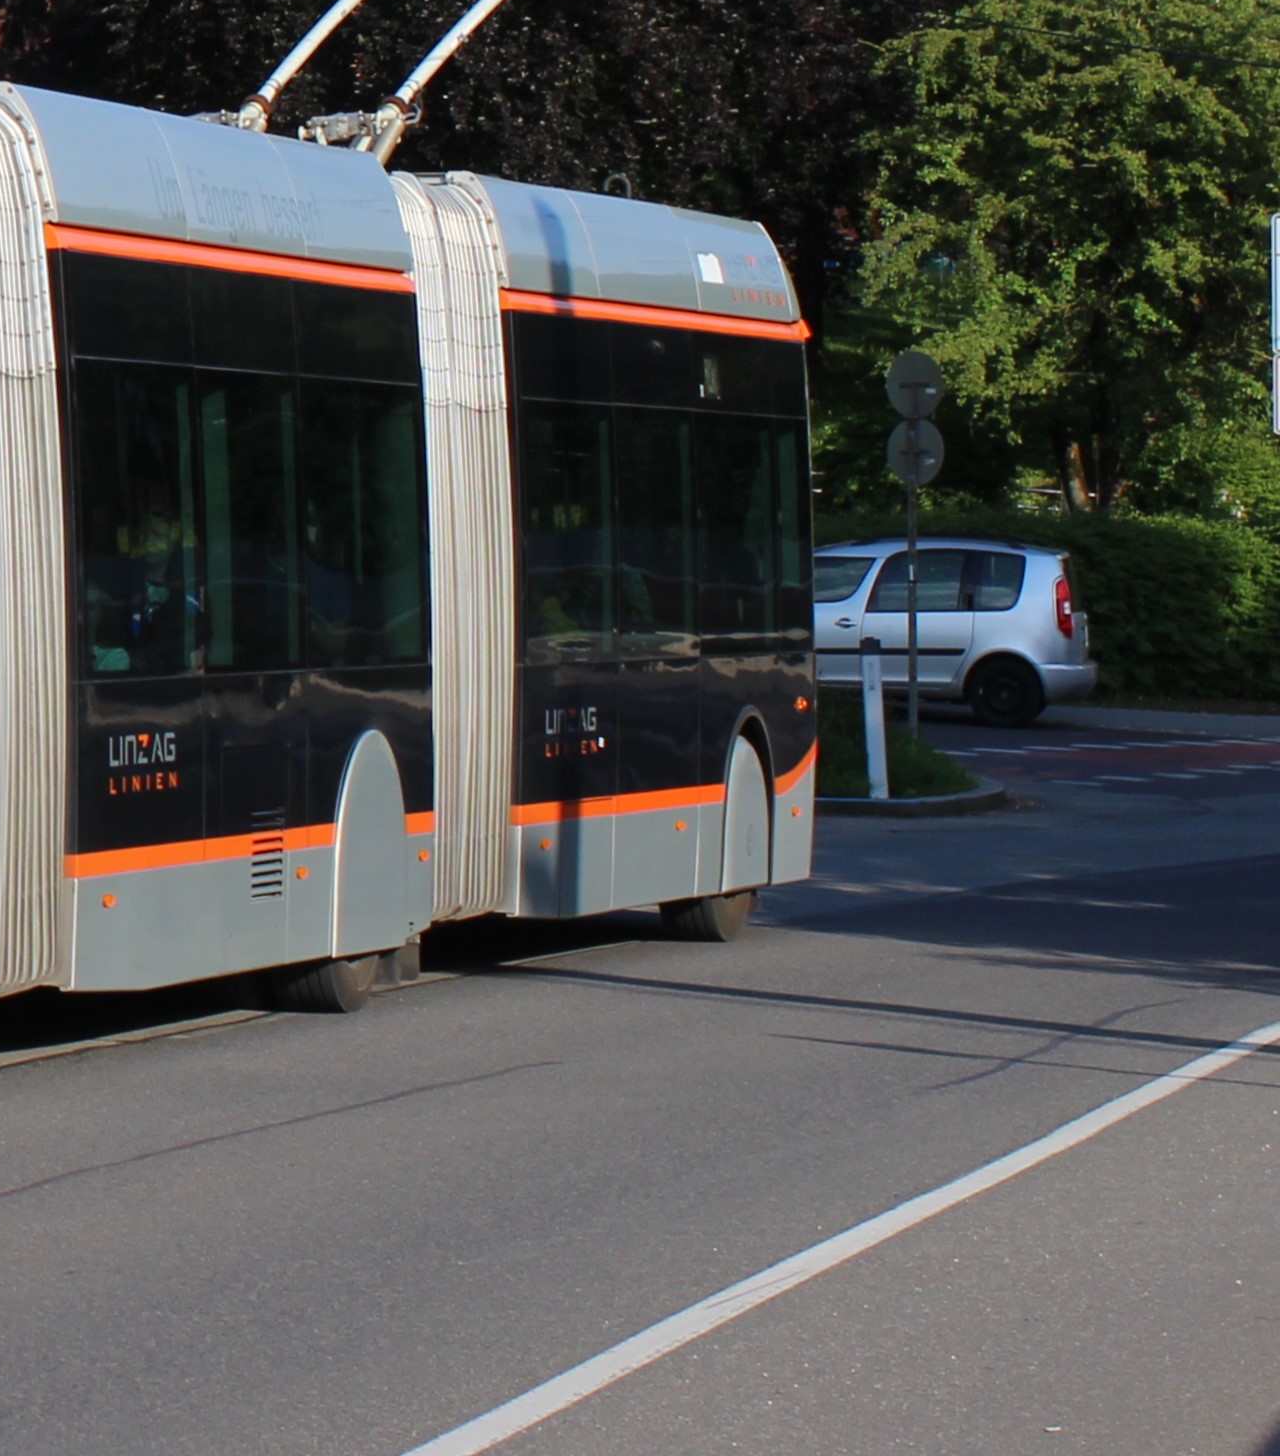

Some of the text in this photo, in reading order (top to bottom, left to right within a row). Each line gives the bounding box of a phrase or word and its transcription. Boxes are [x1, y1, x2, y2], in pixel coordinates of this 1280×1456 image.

[108, 731, 176, 767] LINZ AG
[108, 771, 178, 796] LINIEN
